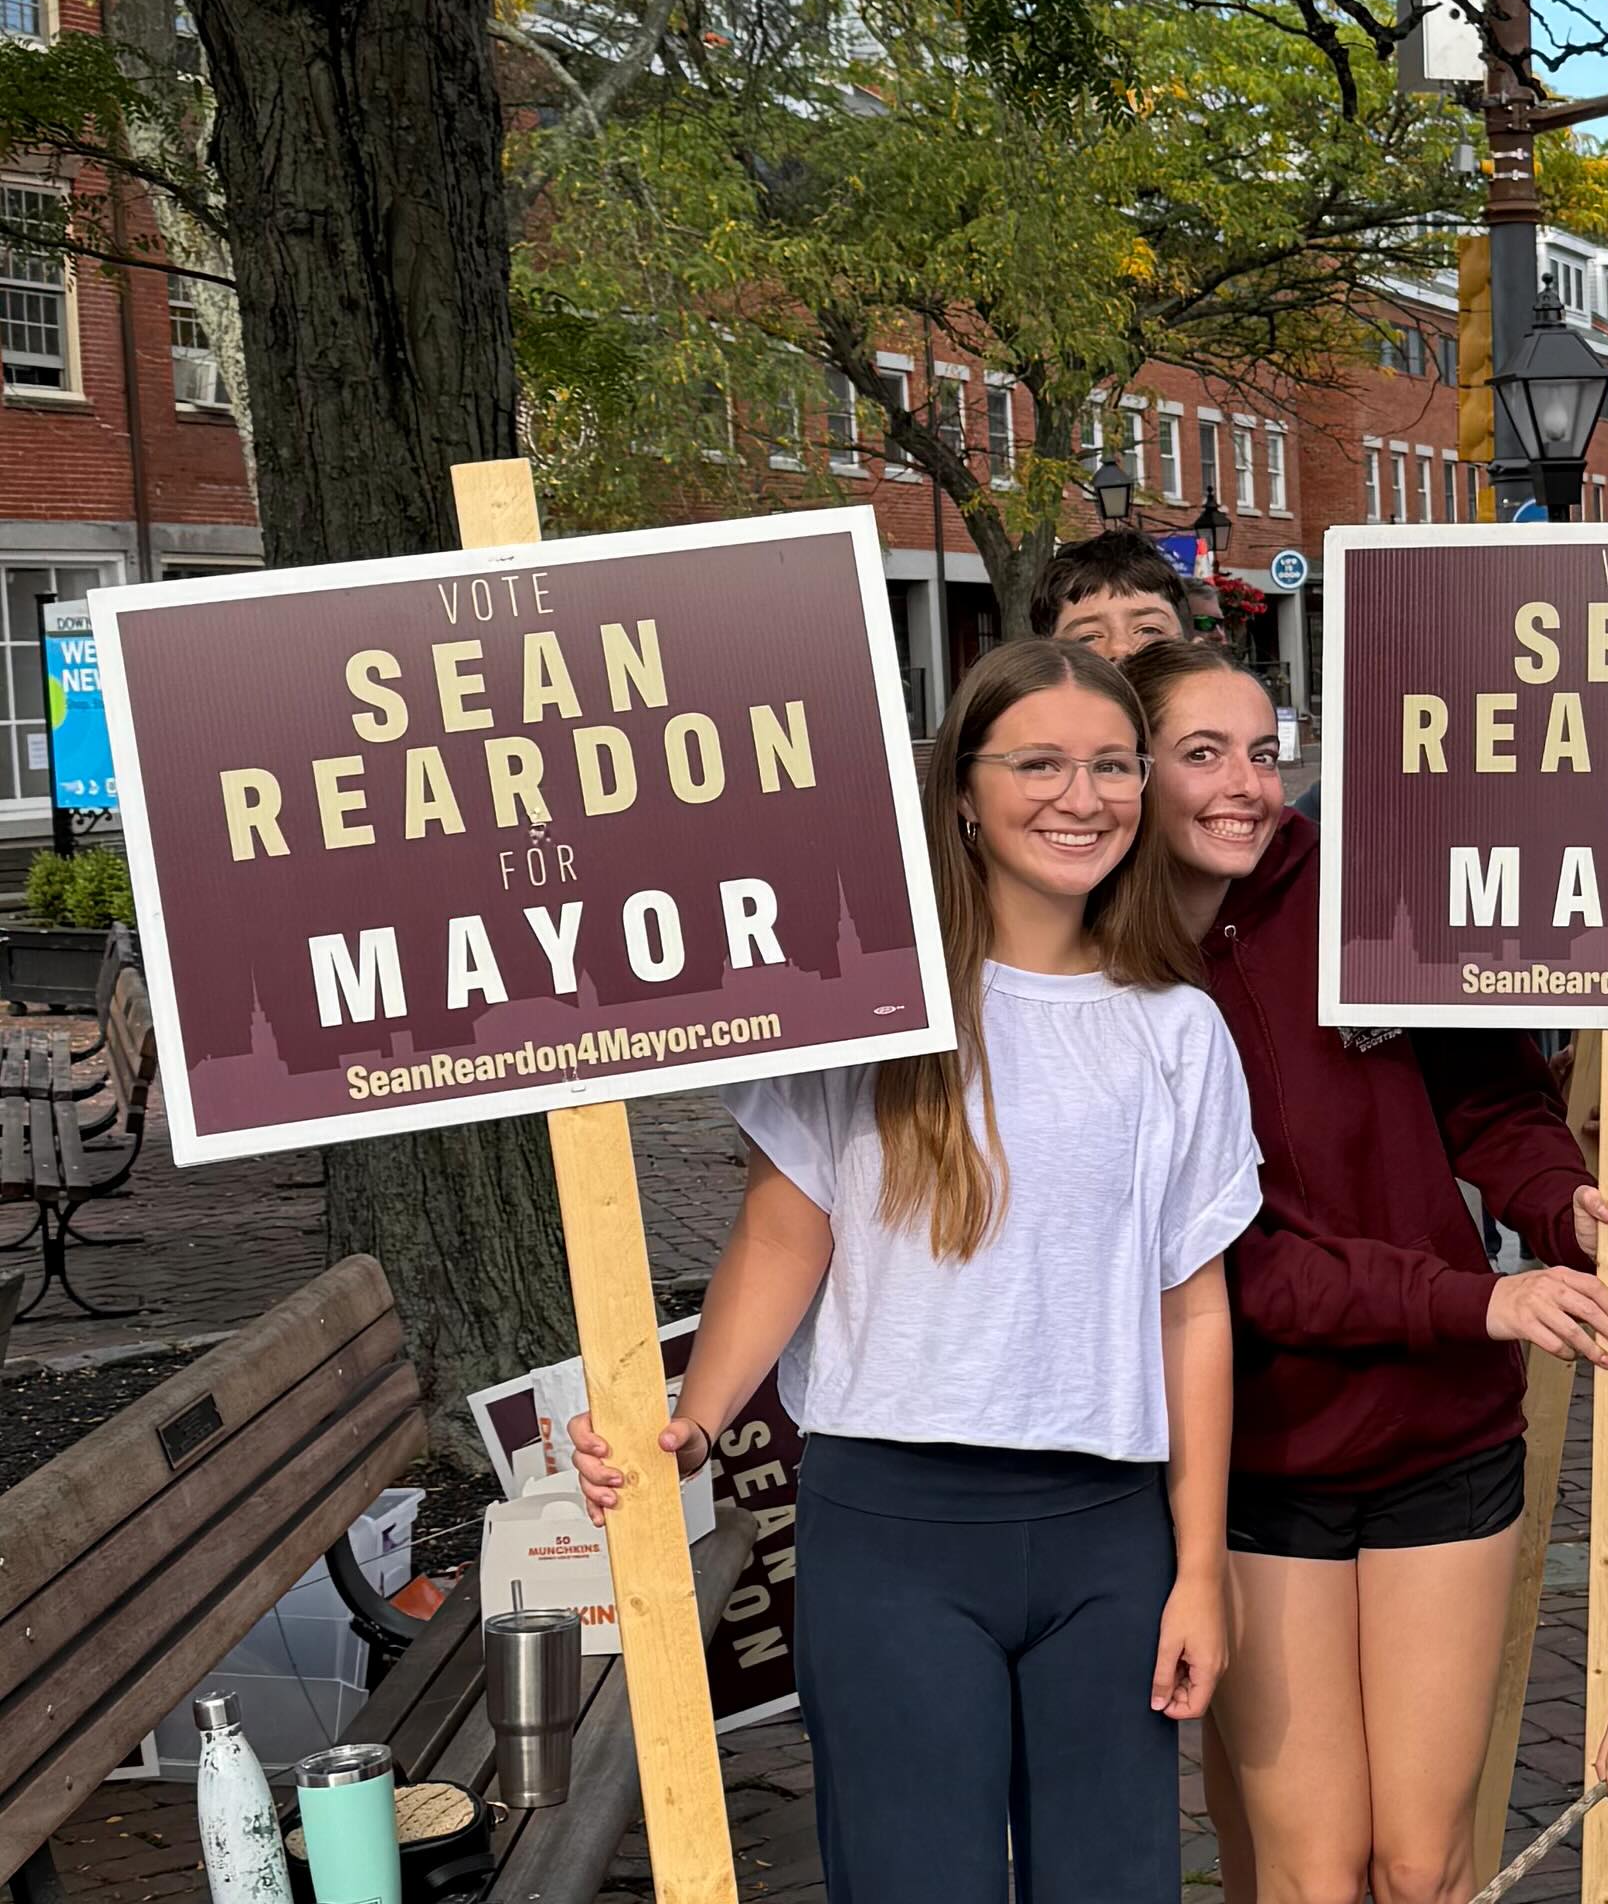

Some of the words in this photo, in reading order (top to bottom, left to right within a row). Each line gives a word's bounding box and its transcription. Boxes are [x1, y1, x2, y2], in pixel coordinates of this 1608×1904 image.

[437, 571, 555, 625] VOTE
[345, 618, 669, 743] SEAN
[219, 699, 817, 862] REARDON
[499, 844, 578, 890] FOR
[308, 877, 787, 1028] MAYOR
[346, 1013, 782, 1100] SeanReardon4Mayor.com
[528, 1543, 600, 1557] MUNCHKINS
